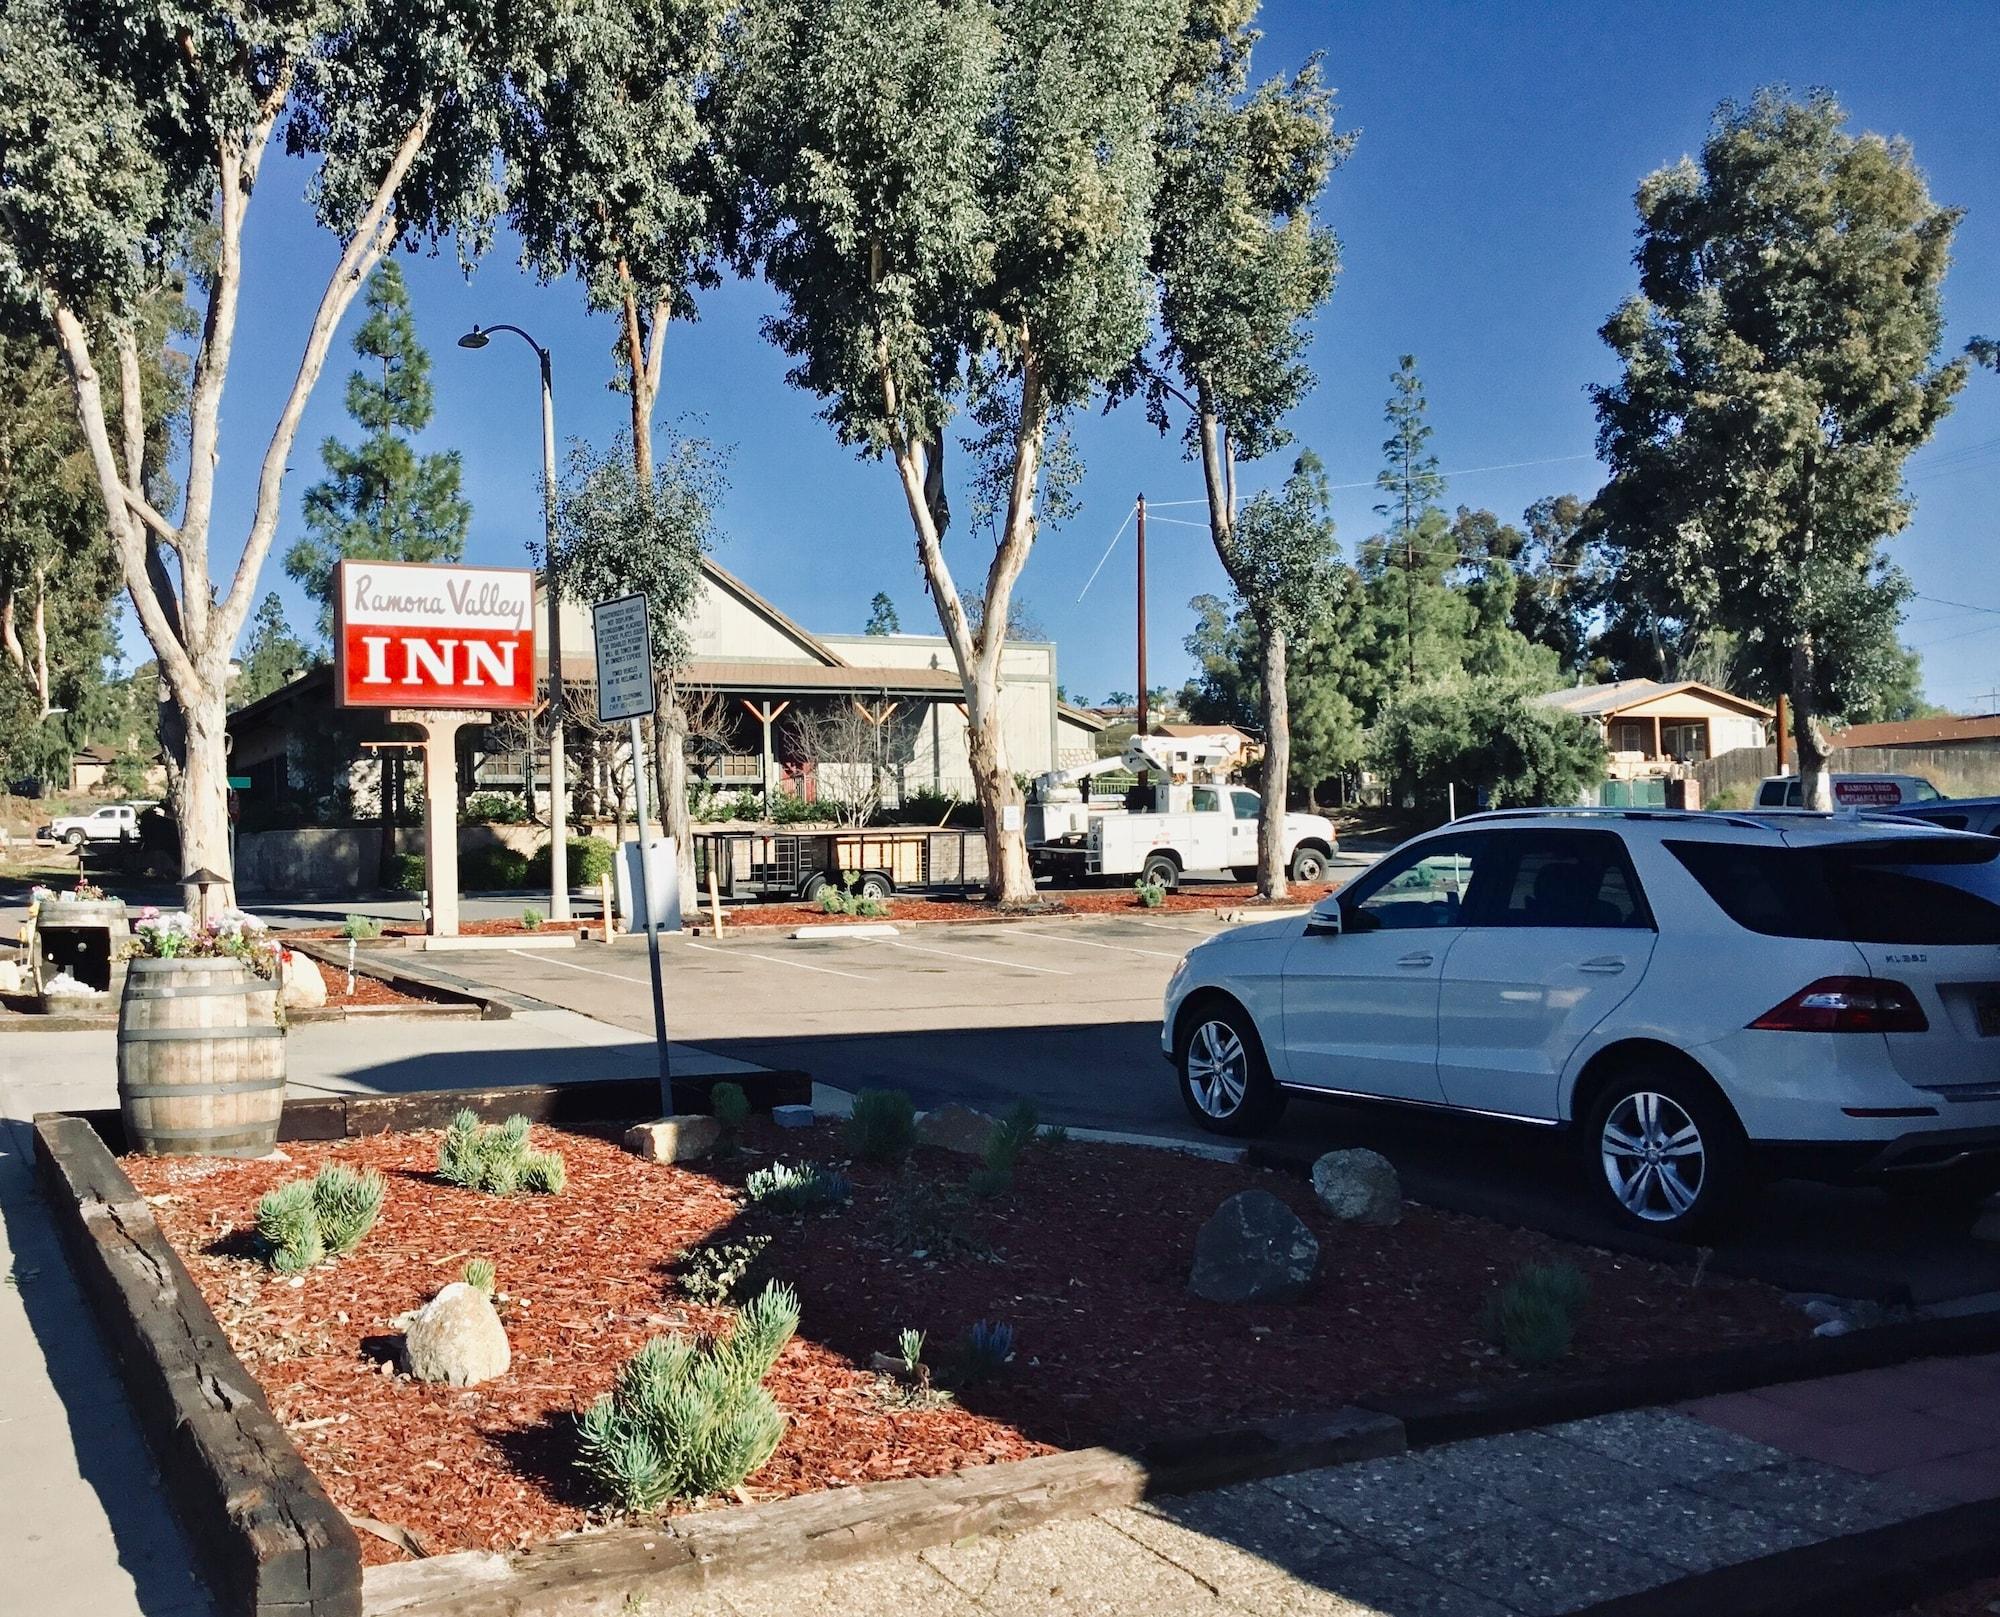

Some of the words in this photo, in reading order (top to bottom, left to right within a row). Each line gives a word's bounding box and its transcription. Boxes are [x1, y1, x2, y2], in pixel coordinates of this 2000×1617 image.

[354, 574, 446, 615] Ramona
[447, 579, 524, 636] Valley
[362, 636, 519, 686] INN
